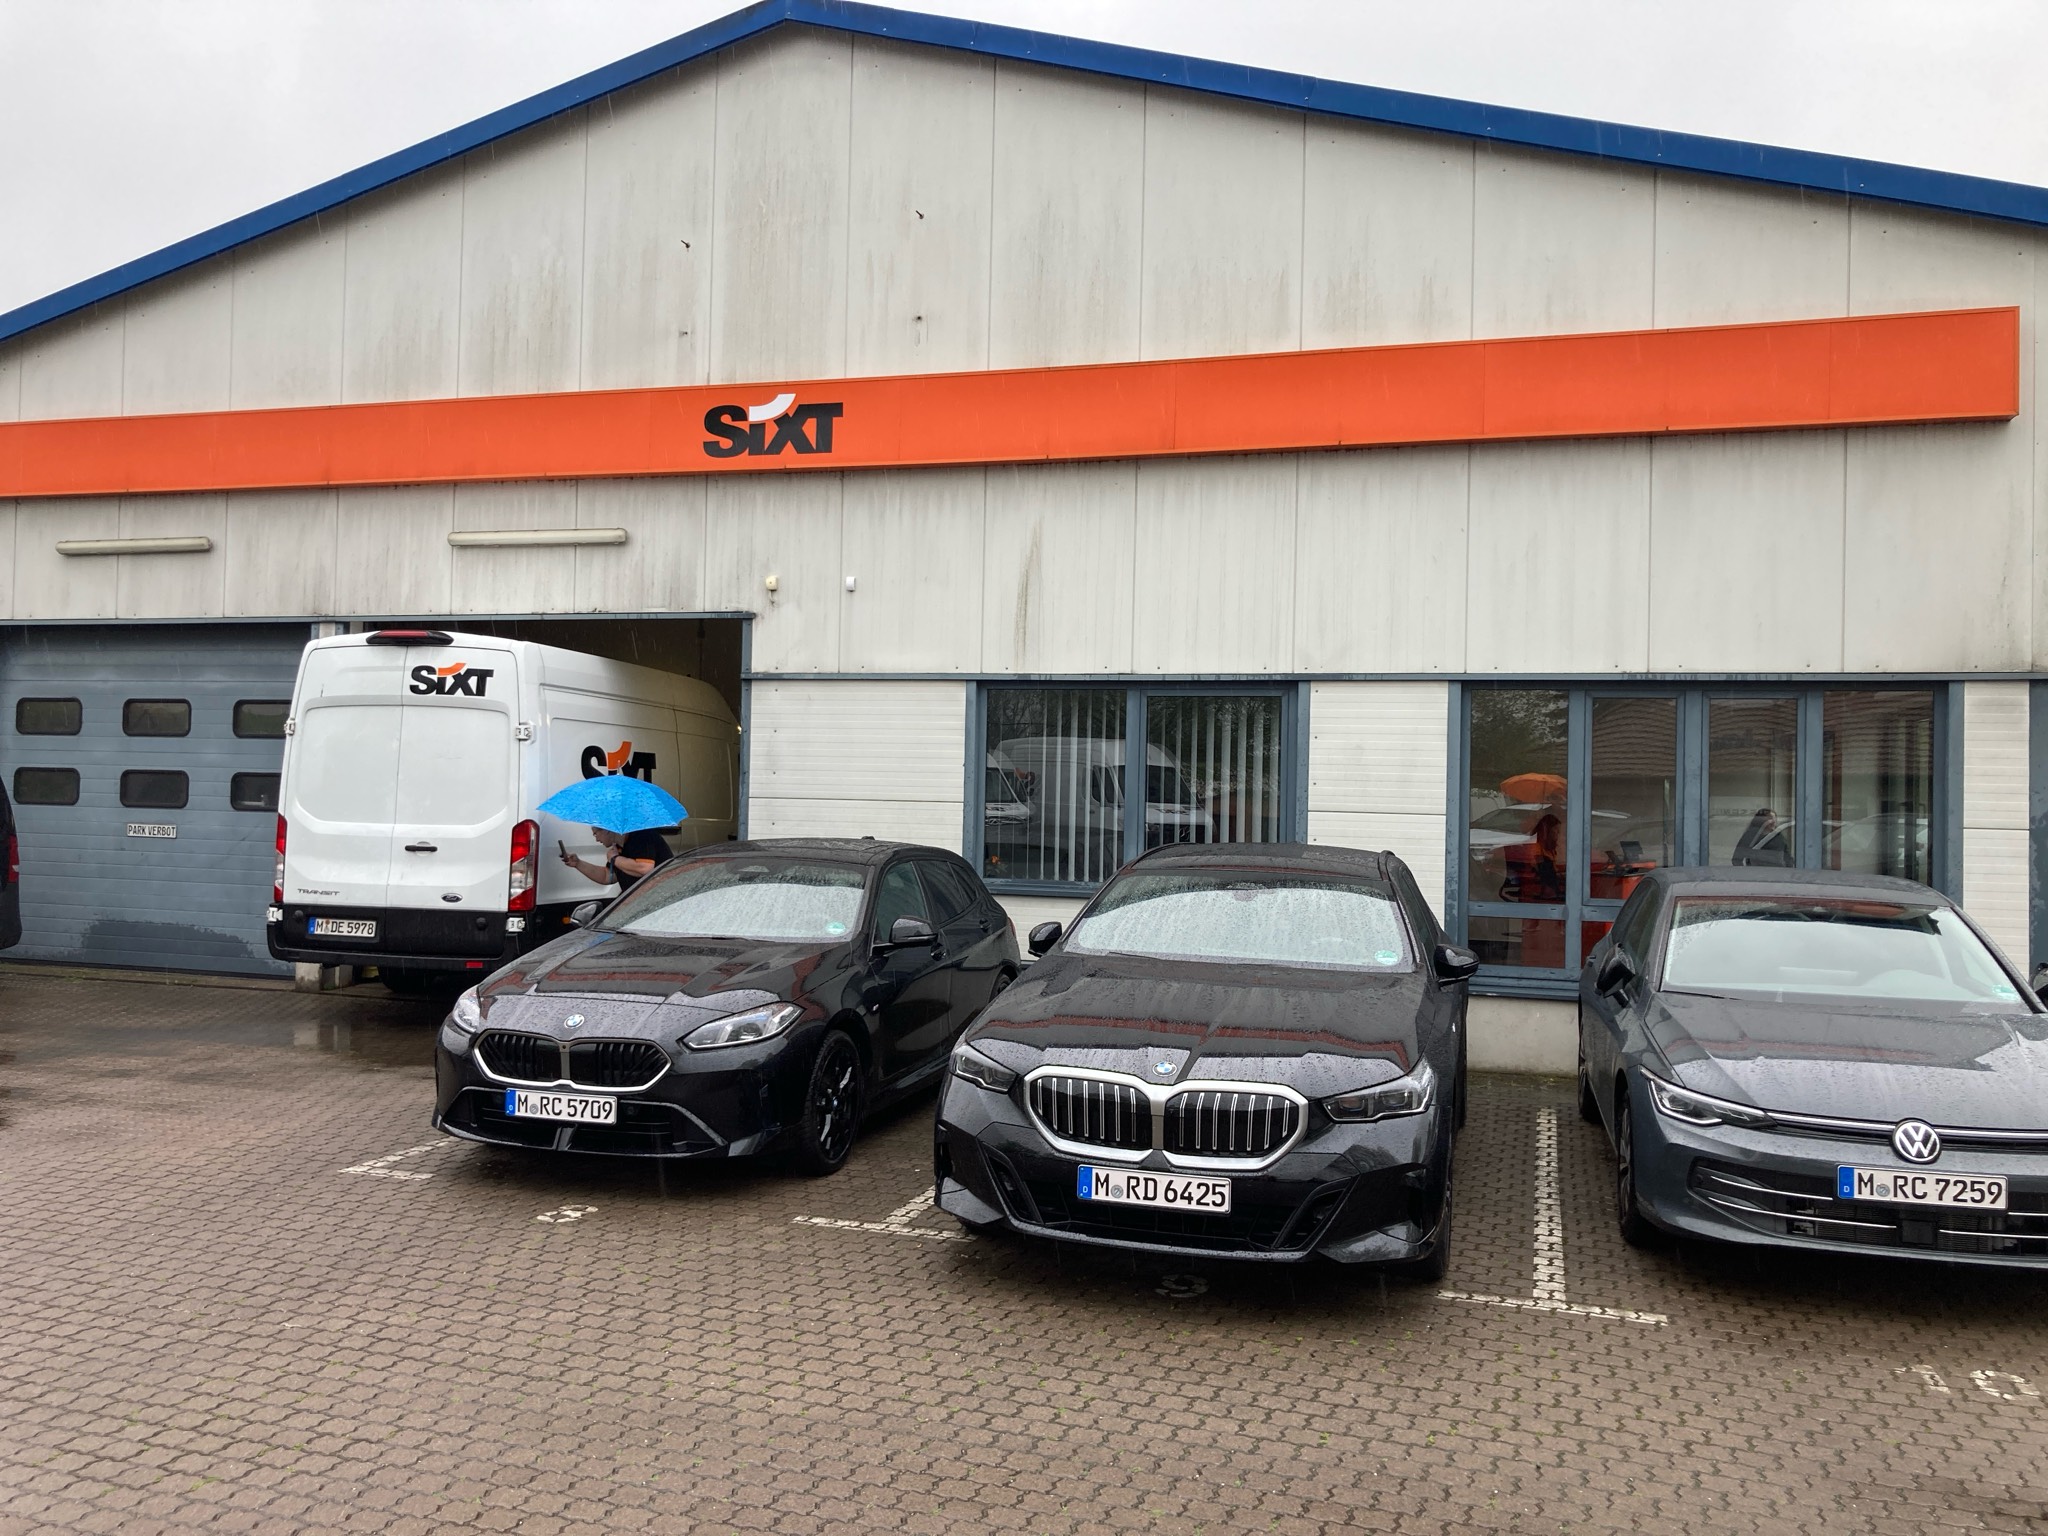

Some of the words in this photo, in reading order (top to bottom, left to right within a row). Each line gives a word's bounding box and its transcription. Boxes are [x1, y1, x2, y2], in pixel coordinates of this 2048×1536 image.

[703, 393, 844, 458] SIXT
[409, 662, 494, 697] SIXT
[128, 825, 147, 836] PARK
[148, 826, 176, 837] VERBOT
[347, 922, 374, 935] 5978
[517, 1094, 528, 1113] M
[540, 1096, 562, 1116] RC
[567, 1099, 613, 1120] 5709
[1094, 1172, 1110, 1196] M
[1126, 1176, 1158, 1201] RD
[1164, 1180, 1226, 1207] 6425
[1857, 1172, 1874, 1195] M
[1893, 1175, 1928, 1199] RC
[1935, 1178, 2003, 1205] 7259
